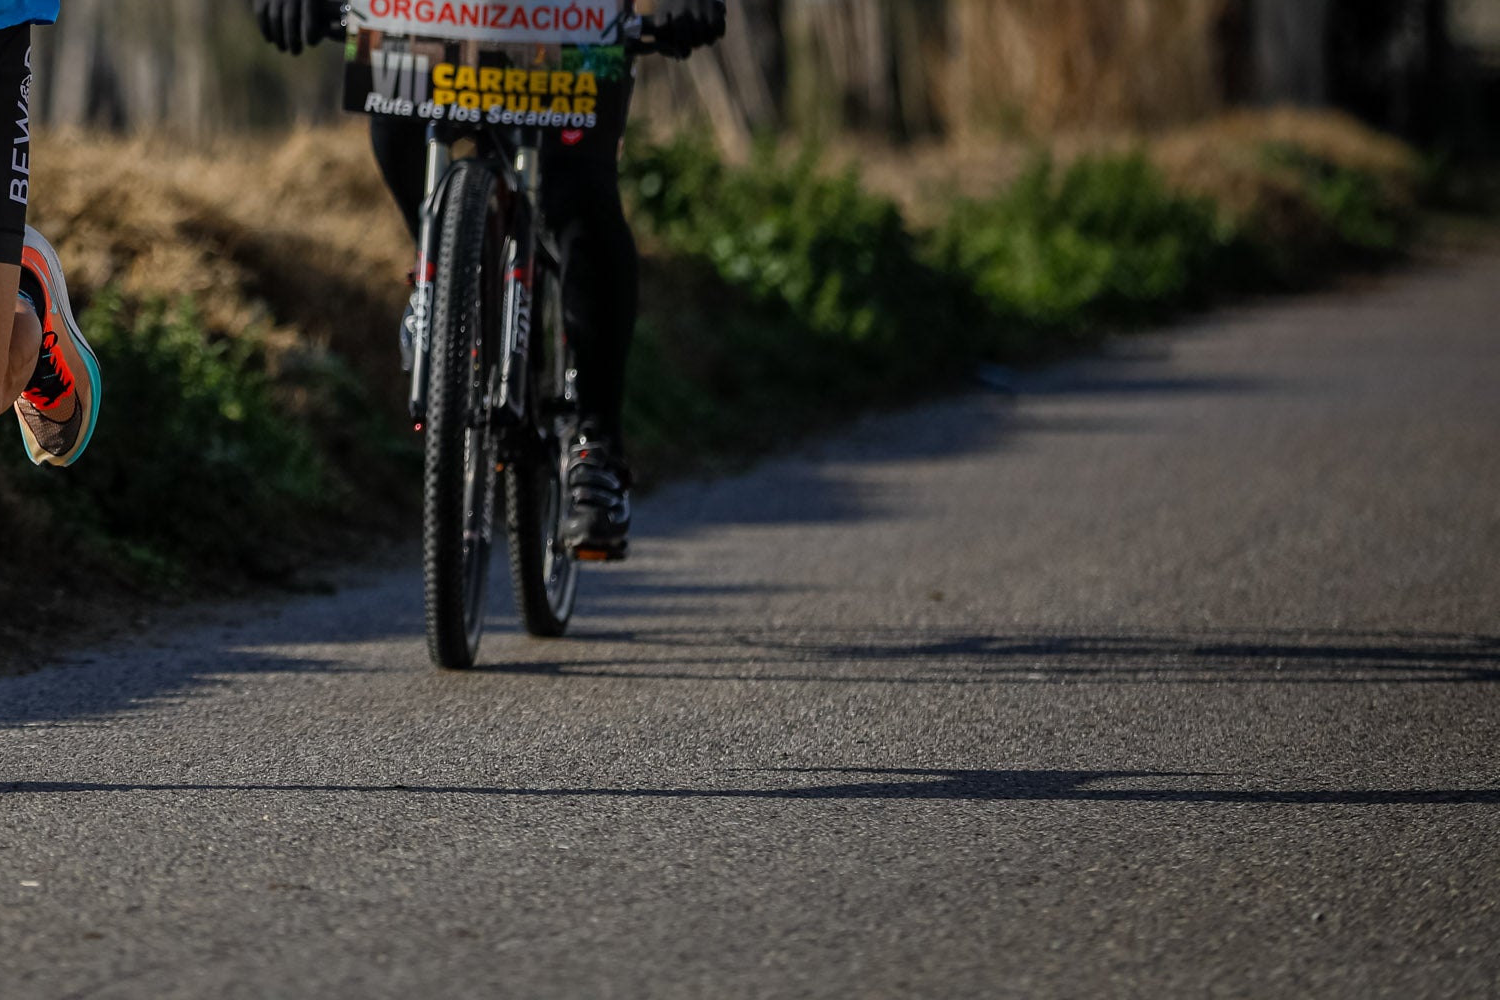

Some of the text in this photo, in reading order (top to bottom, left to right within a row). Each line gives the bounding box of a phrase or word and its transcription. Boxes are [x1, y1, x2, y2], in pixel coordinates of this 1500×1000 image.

[370, 51, 430, 104] VII
[432, 62, 597, 96] CARRERA
[364, 92, 597, 128] Ruta de los Secaderos
[432, 87, 597, 114] POPULAR
